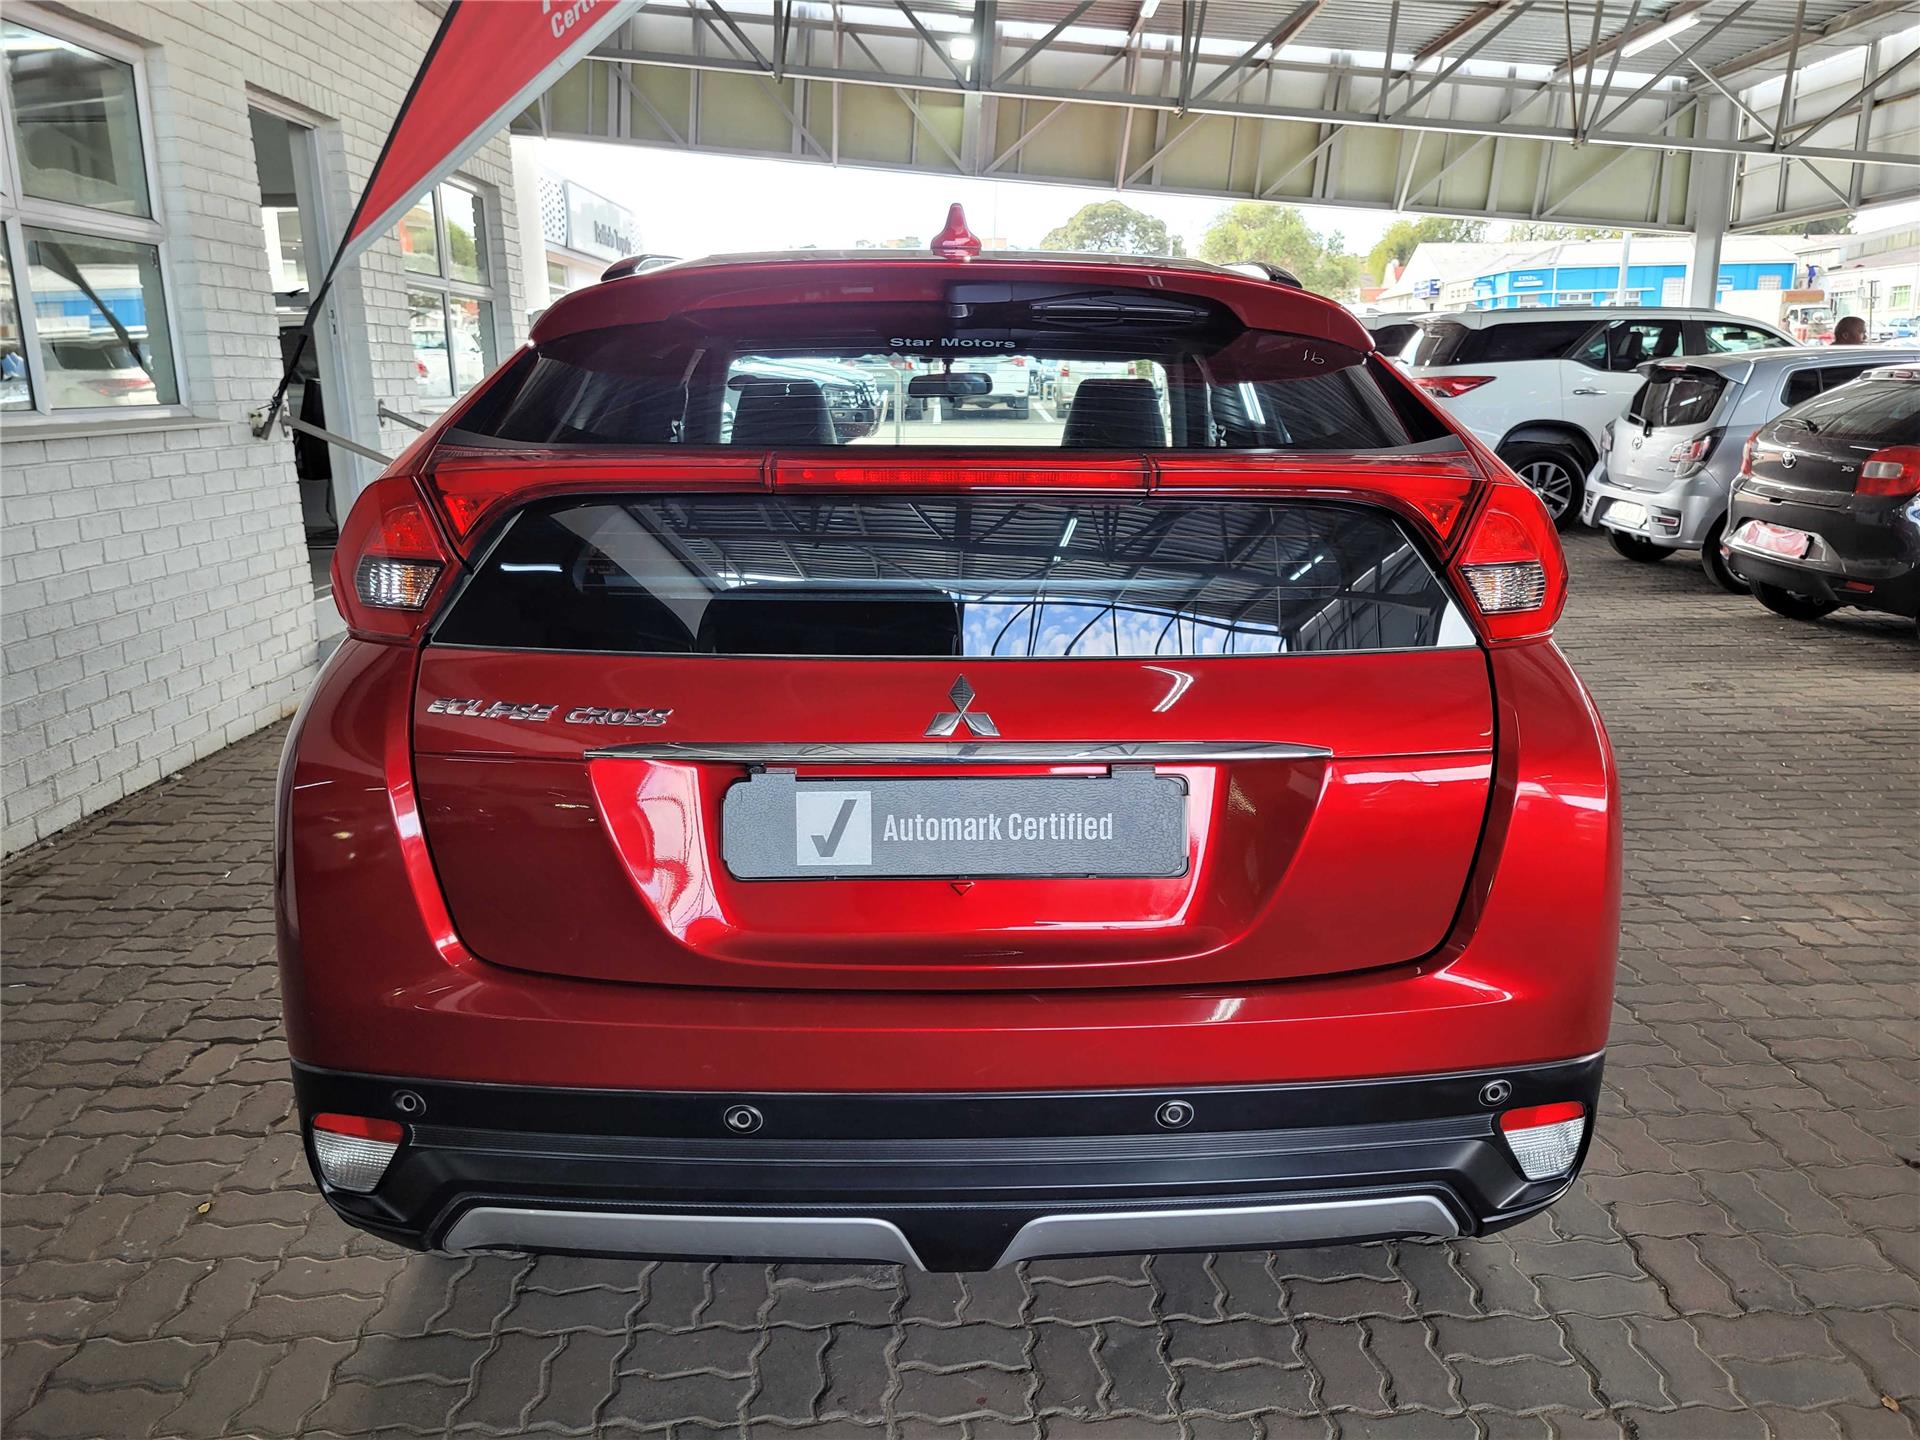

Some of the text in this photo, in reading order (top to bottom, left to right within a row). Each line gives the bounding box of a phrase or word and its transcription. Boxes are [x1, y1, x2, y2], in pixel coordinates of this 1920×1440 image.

[889, 337, 1016, 348] Star Motors
[426, 698, 674, 727] ECLIPSE CROSS
[883, 812, 1113, 842] Automark Certified
